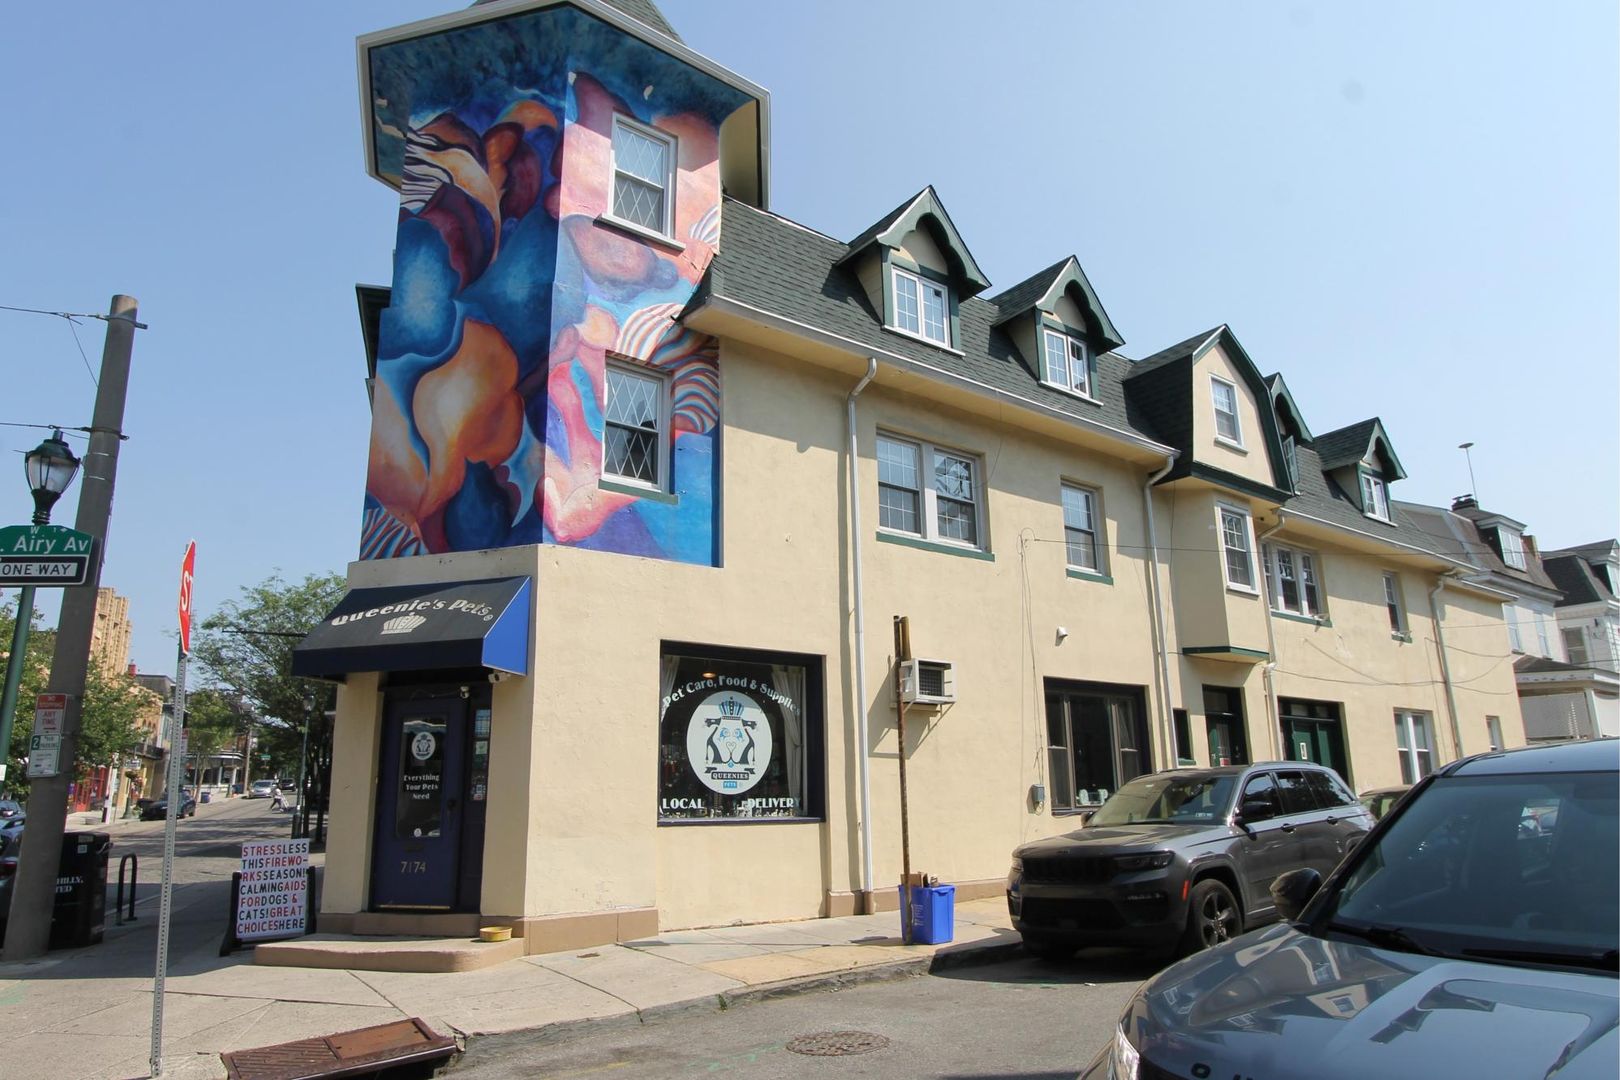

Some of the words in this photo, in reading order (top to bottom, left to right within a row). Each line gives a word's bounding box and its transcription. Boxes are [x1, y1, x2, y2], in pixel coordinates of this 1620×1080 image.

[13, 534, 57, 554] Airy
[63, 536, 89, 552] Av
[2, 563, 33, 576] ONE
[40, 563, 71, 576] WAY
[331, 599, 447, 626] Queenie's
[448, 598, 493, 617] Pets
[662, 687, 685, 708] Pet
[718, 674, 748, 688] Food
[749, 679, 758, 690] &
[712, 771, 750, 780] QUEENIES
[662, 798, 704, 810] LOCAL
